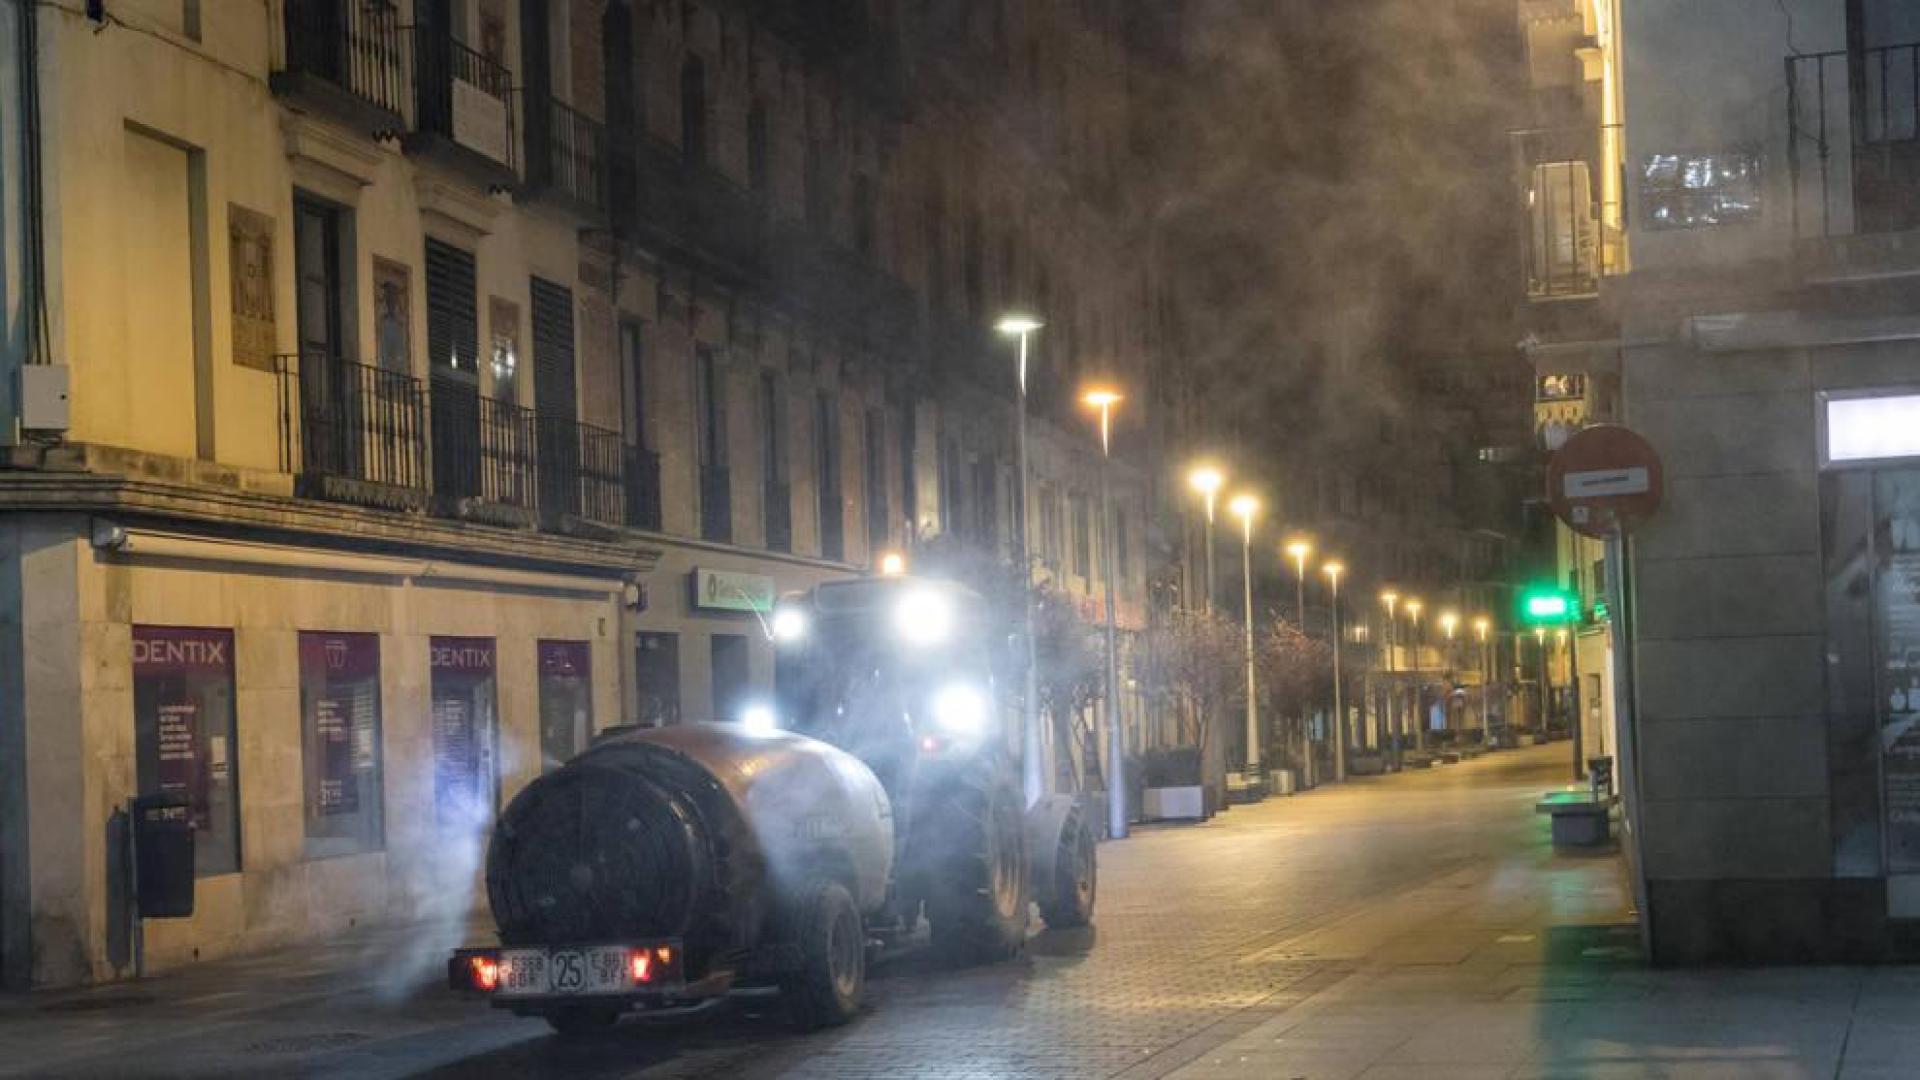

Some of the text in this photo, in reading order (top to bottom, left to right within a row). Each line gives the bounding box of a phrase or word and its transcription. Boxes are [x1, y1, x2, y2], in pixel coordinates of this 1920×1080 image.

[132, 639, 224, 664] DENTIX
[431, 649, 491, 668] DENTIX
[555, 955, 581, 987] 25
